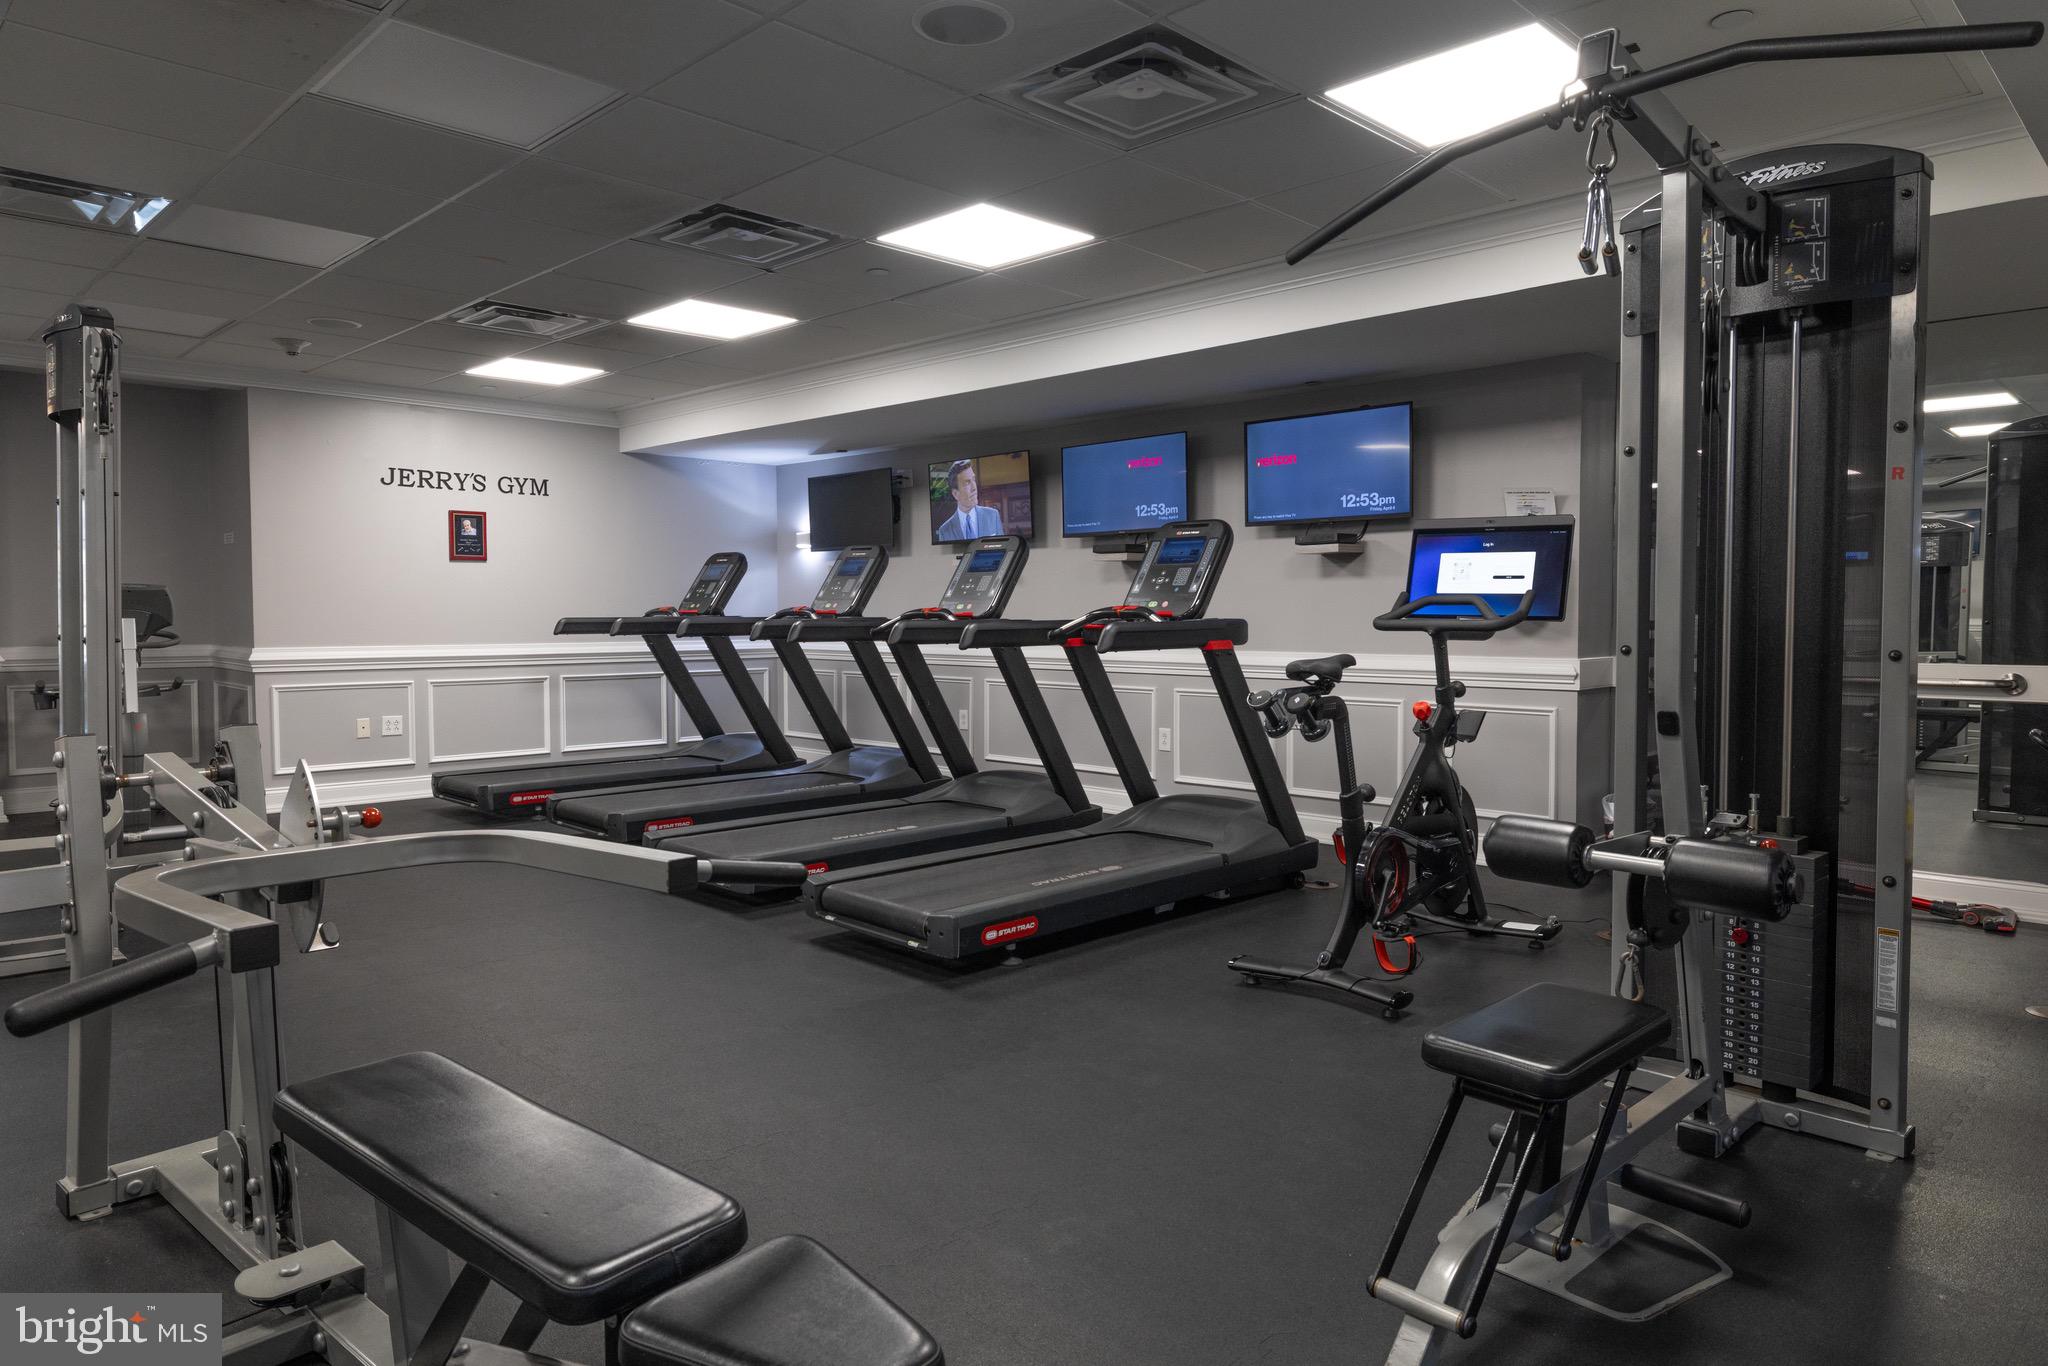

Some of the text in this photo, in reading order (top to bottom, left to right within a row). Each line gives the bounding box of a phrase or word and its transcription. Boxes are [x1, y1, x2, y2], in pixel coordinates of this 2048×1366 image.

[1745, 160, 1827, 186] Fitness
[1891, 466, 1905, 480] R
[380, 467, 550, 497] JERRY'S GYM
[1340, 492, 1396, 508] 12:53pm
[1135, 503, 1179, 517] 12:53pm
[998, 922, 1035, 937] STAR TRAC
[1752, 956, 1760, 964] 11
[1749, 1046, 1758, 1054] 19
[1723, 1062, 1732, 1070] 21
[1747, 1068, 1758, 1076] 21
